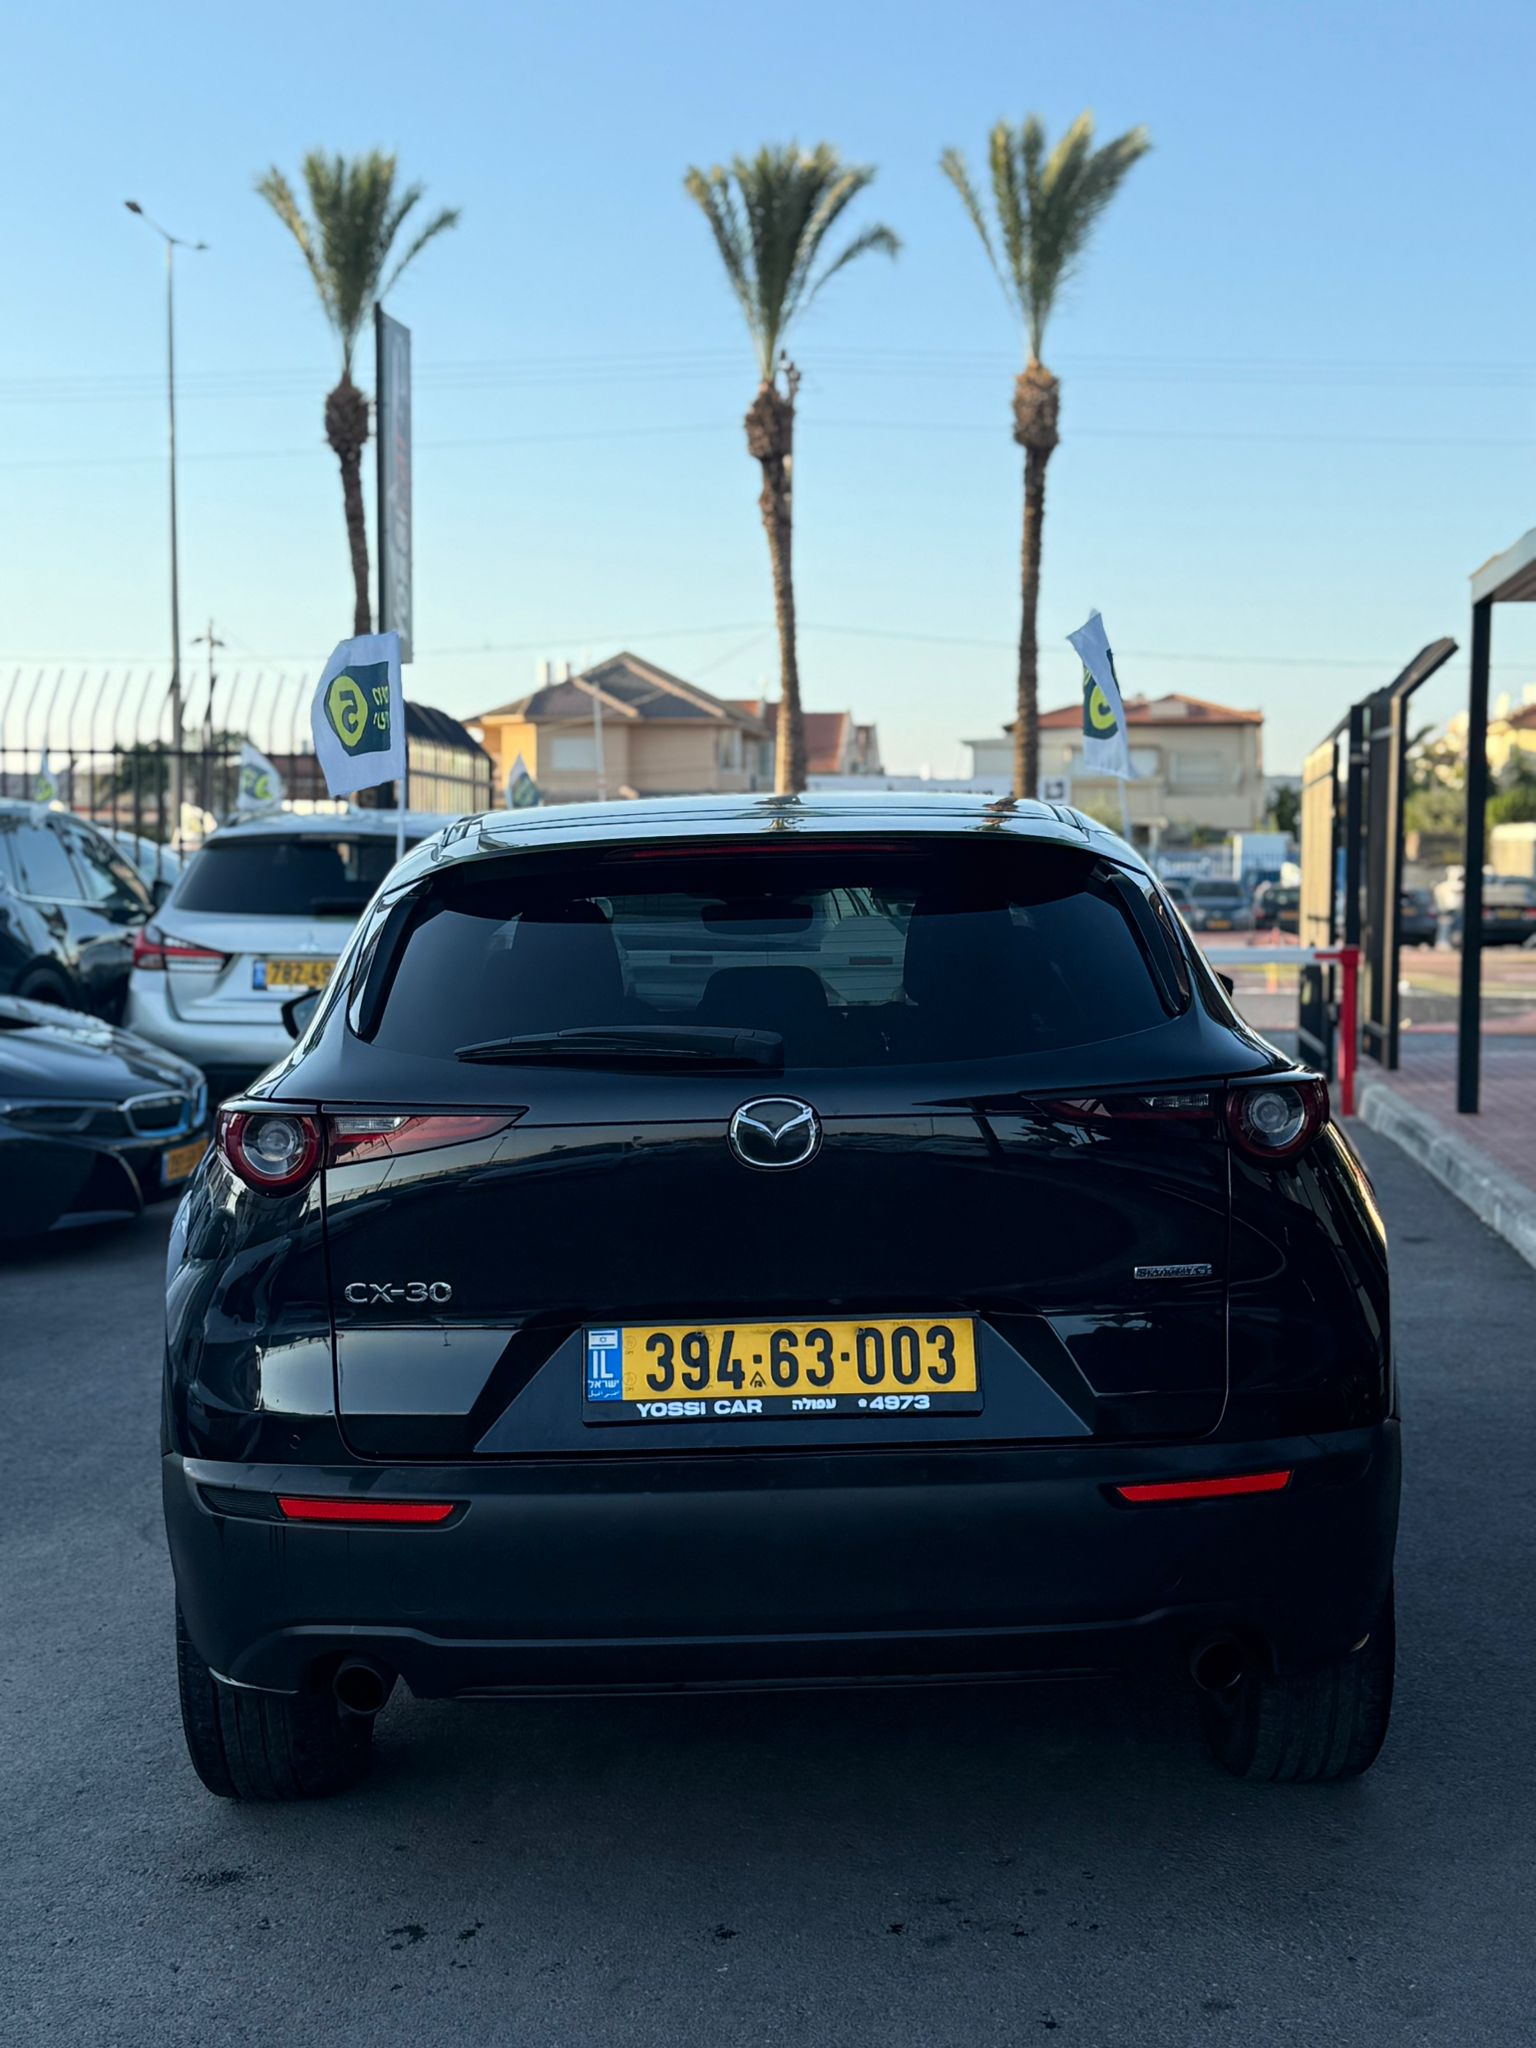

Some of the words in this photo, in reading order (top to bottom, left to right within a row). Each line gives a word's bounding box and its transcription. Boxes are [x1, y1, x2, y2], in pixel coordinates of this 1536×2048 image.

[344, 1282, 453, 1304] CX-30
[592, 1350, 614, 1379] IL
[588, 1379, 619, 1389] ישראל
[636, 1401, 706, 1418] YOSSI
[713, 1399, 763, 1415] CAR
